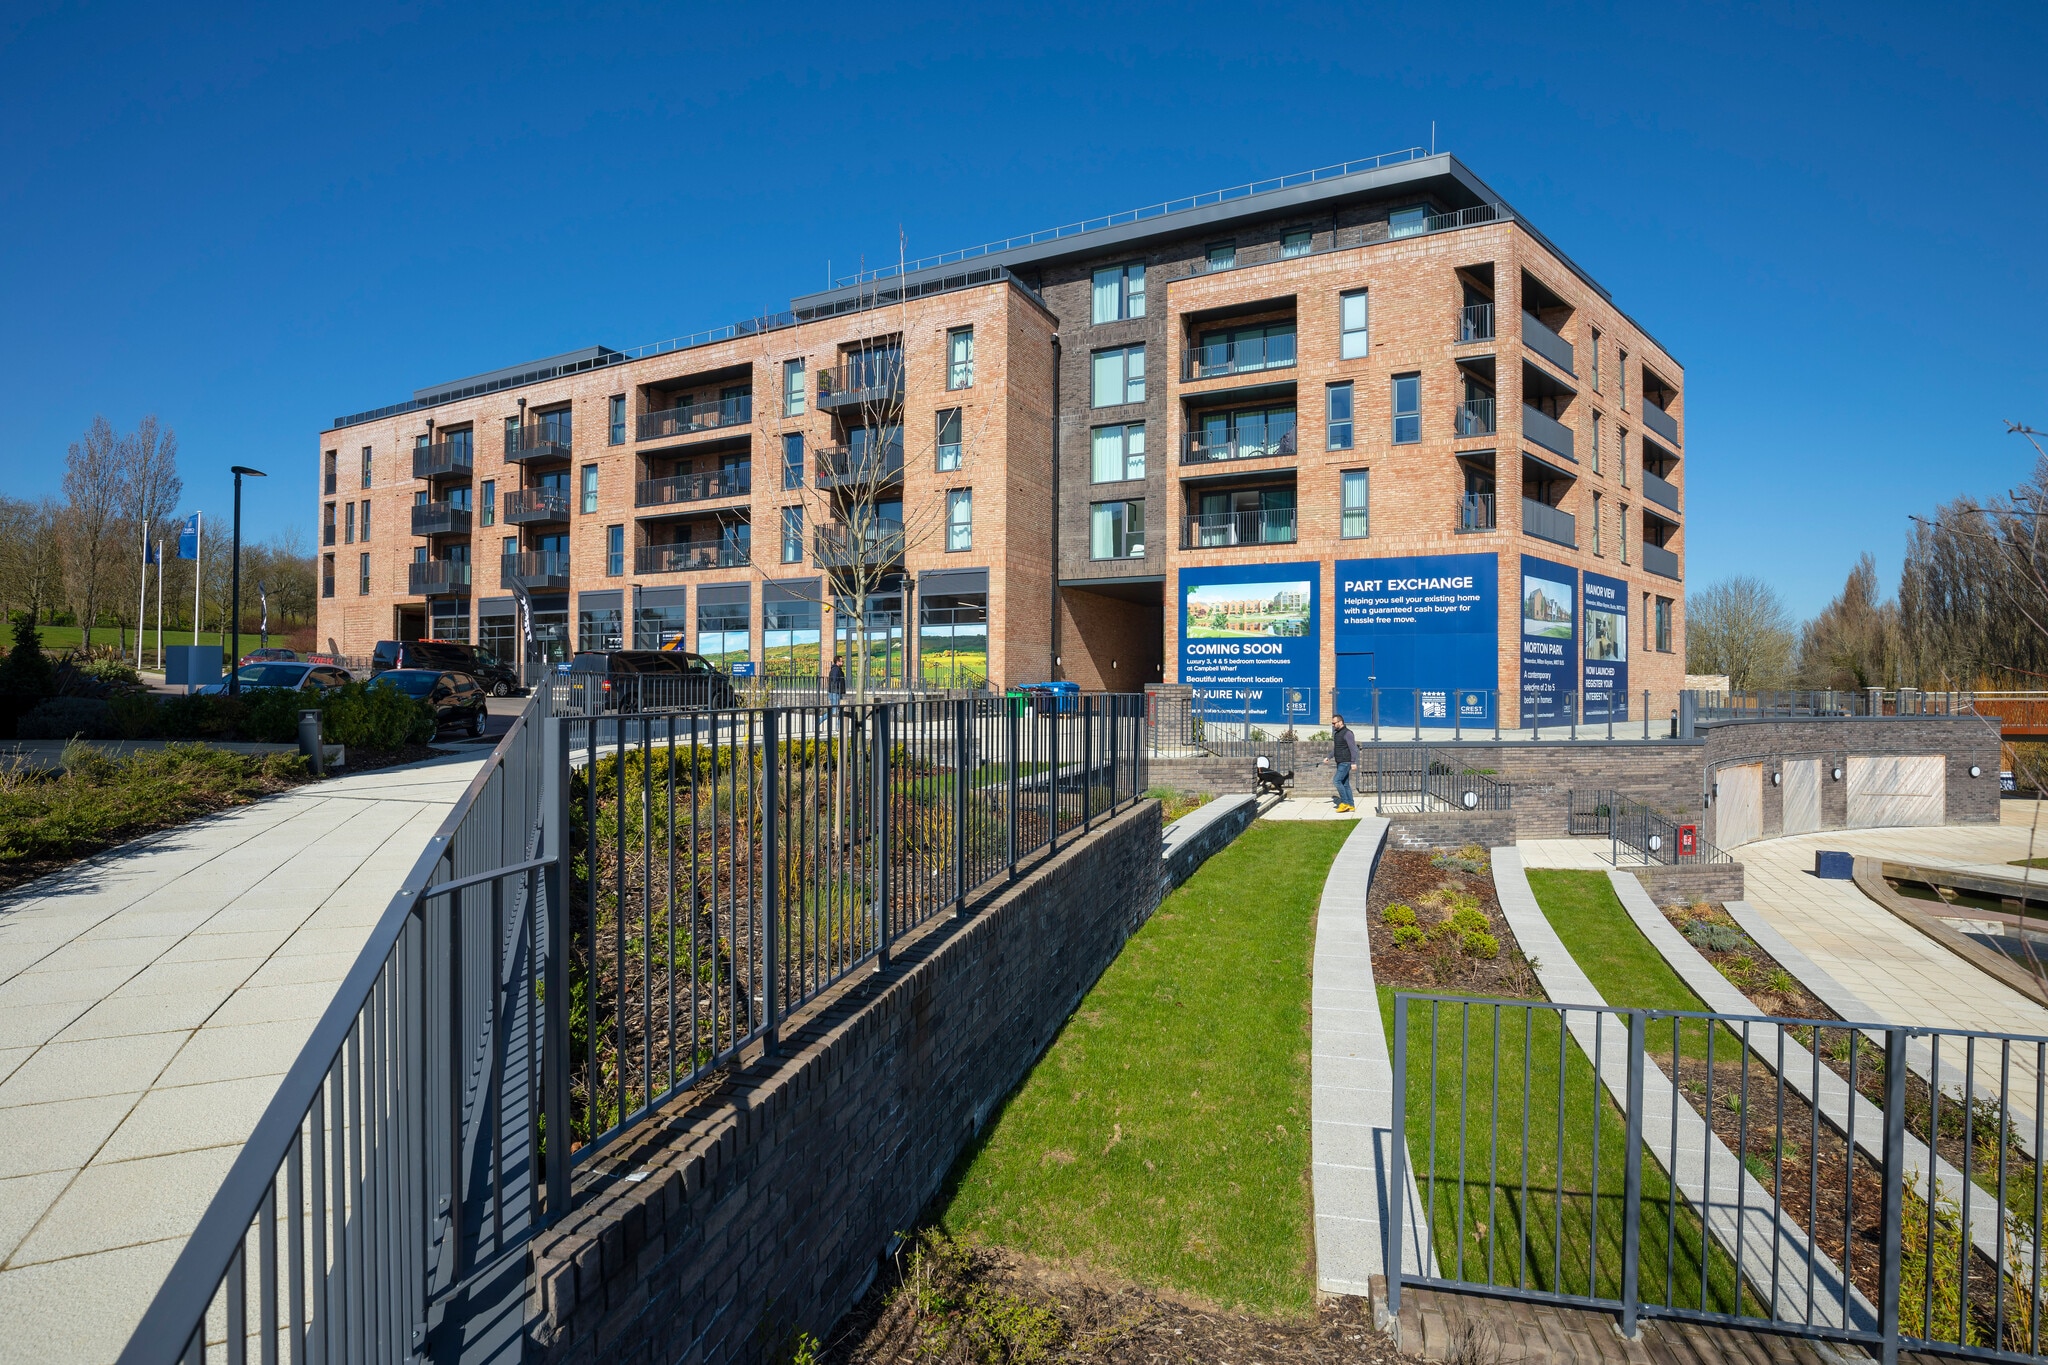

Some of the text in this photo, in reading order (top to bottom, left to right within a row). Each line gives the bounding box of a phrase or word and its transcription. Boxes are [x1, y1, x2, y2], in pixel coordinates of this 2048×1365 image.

[1344, 576, 1472, 592] PART EXCHANGE
[1586, 583, 1615, 599] MANOR VIEW
[1344, 598, 1373, 606] Helping
[1424, 595, 1455, 603] existing
[1369, 606, 1412, 615] guaranteed
[1434, 605, 1457, 614] buyer
[1187, 643, 1282, 655] COMING SOON
[1524, 642, 1563, 655] MORTON PARK
[1524, 670, 1527, 678] A
[1586, 666, 1615, 676] NOW LAUNCHED
[1586, 680, 1603, 688] REGISTER
